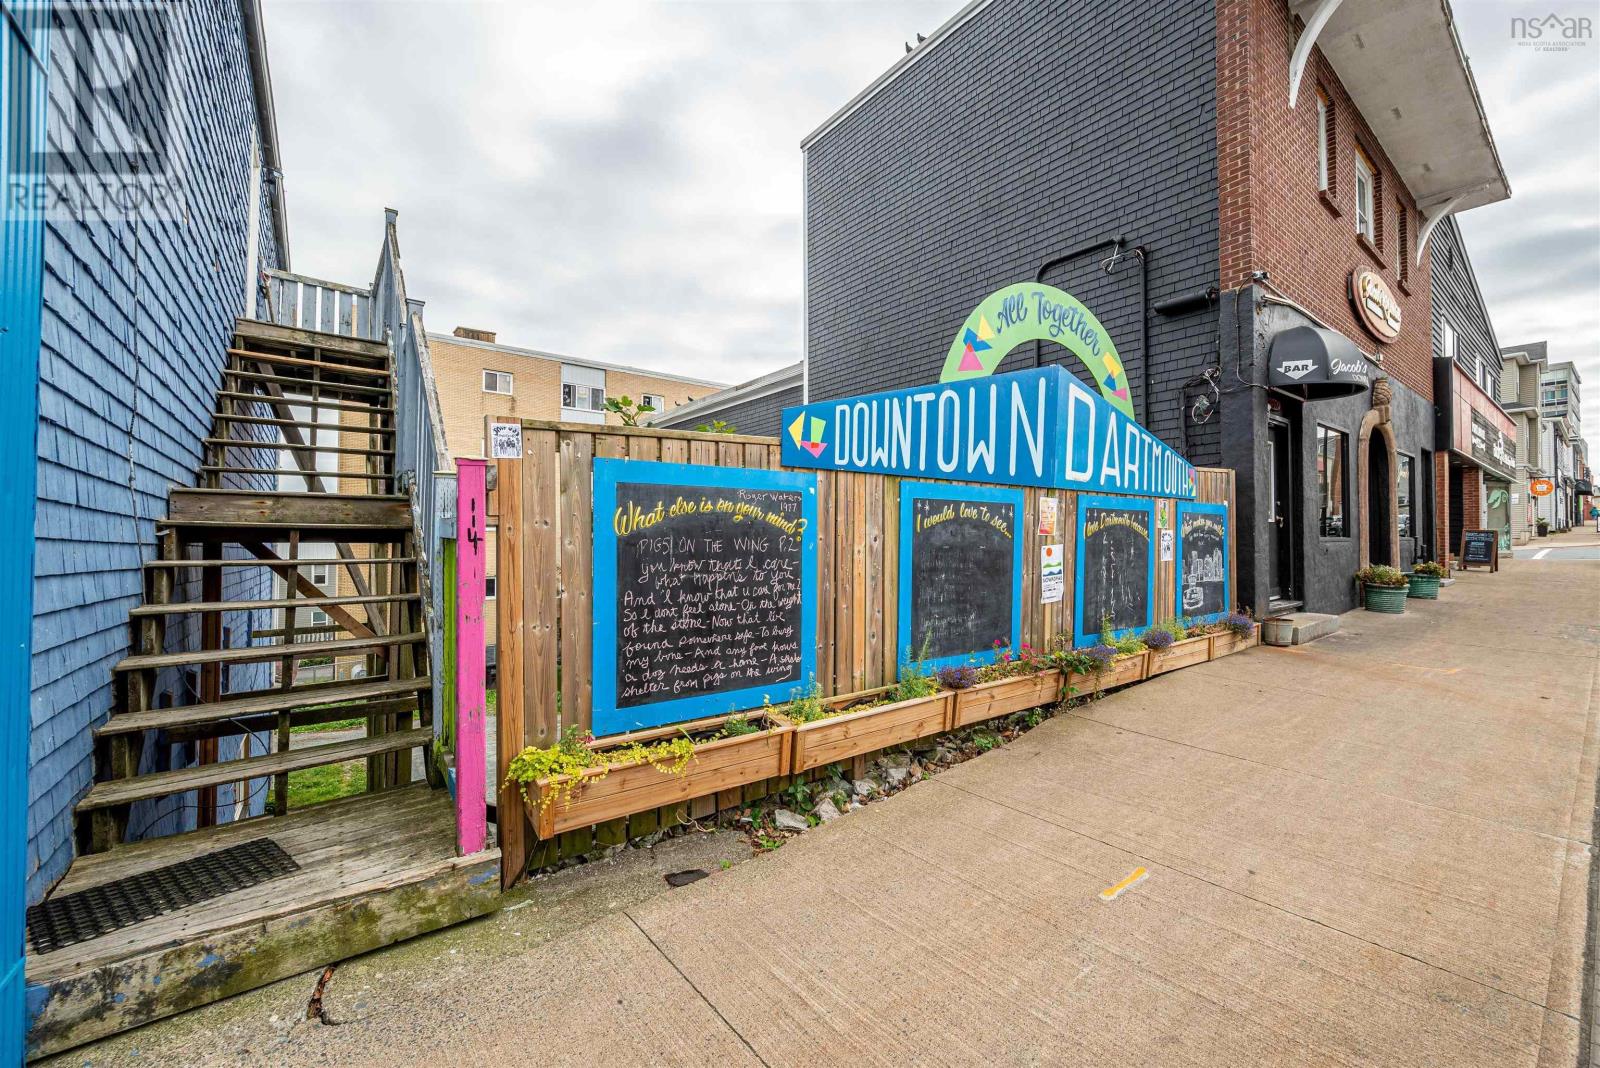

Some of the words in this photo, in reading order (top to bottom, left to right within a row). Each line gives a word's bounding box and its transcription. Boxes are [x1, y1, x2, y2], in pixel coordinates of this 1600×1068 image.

[996, 292, 1028, 334] All
[1031, 291, 1101, 356] Together
[1284, 364, 1309, 374] BAR
[1330, 358, 1368, 375] Jacob's
[834, 377, 1046, 478] DOWNTOWN
[1065, 382, 1189, 495] DARTMOUTH
[737, 489, 768, 505] Roger
[770, 492, 802, 502] Waters
[780, 502, 797, 512] 1977
[614, 500, 665, 536] What
[669, 496, 697, 517] else
[700, 497, 713, 513] is
[716, 498, 734, 513] on
[733, 501, 765, 522] your
[766, 512, 808, 541] mind?
[916, 513, 921, 533] I
[923, 503, 955, 529] would
[960, 502, 978, 520] love
[980, 505, 991, 522] to
[639, 536, 672, 555] PIGS
[679, 536, 696, 552] ON
[703, 538, 723, 553] THE
[733, 536, 769, 553] WING
[753, 568, 767, 581] to
[770, 569, 794, 587] you
[624, 590, 655, 607] And
[677, 589, 712, 604] know
[715, 586, 739, 600] that
[623, 608, 638, 622] So
[682, 602, 706, 621] feel
[759, 599, 777, 609] the
[623, 622, 640, 638] of
[642, 619, 667, 635] the
[712, 614, 734, 630] Now
[737, 612, 761, 625] that
[622, 639, 674, 657] found
[772, 625, 795, 638] bury
[625, 655, 649, 669] my
[694, 646, 721, 659] And
[725, 648, 747, 657] any
[621, 681, 670, 698] shelter
[673, 679, 698, 694] from
[702, 672, 728, 689] pigs
[730, 669, 743, 678] on
[745, 667, 762, 678] the
[766, 664, 793, 682] wing
[625, 673, 638, 682] a
[642, 667, 666, 681] dog
[669, 662, 708, 676] needs
